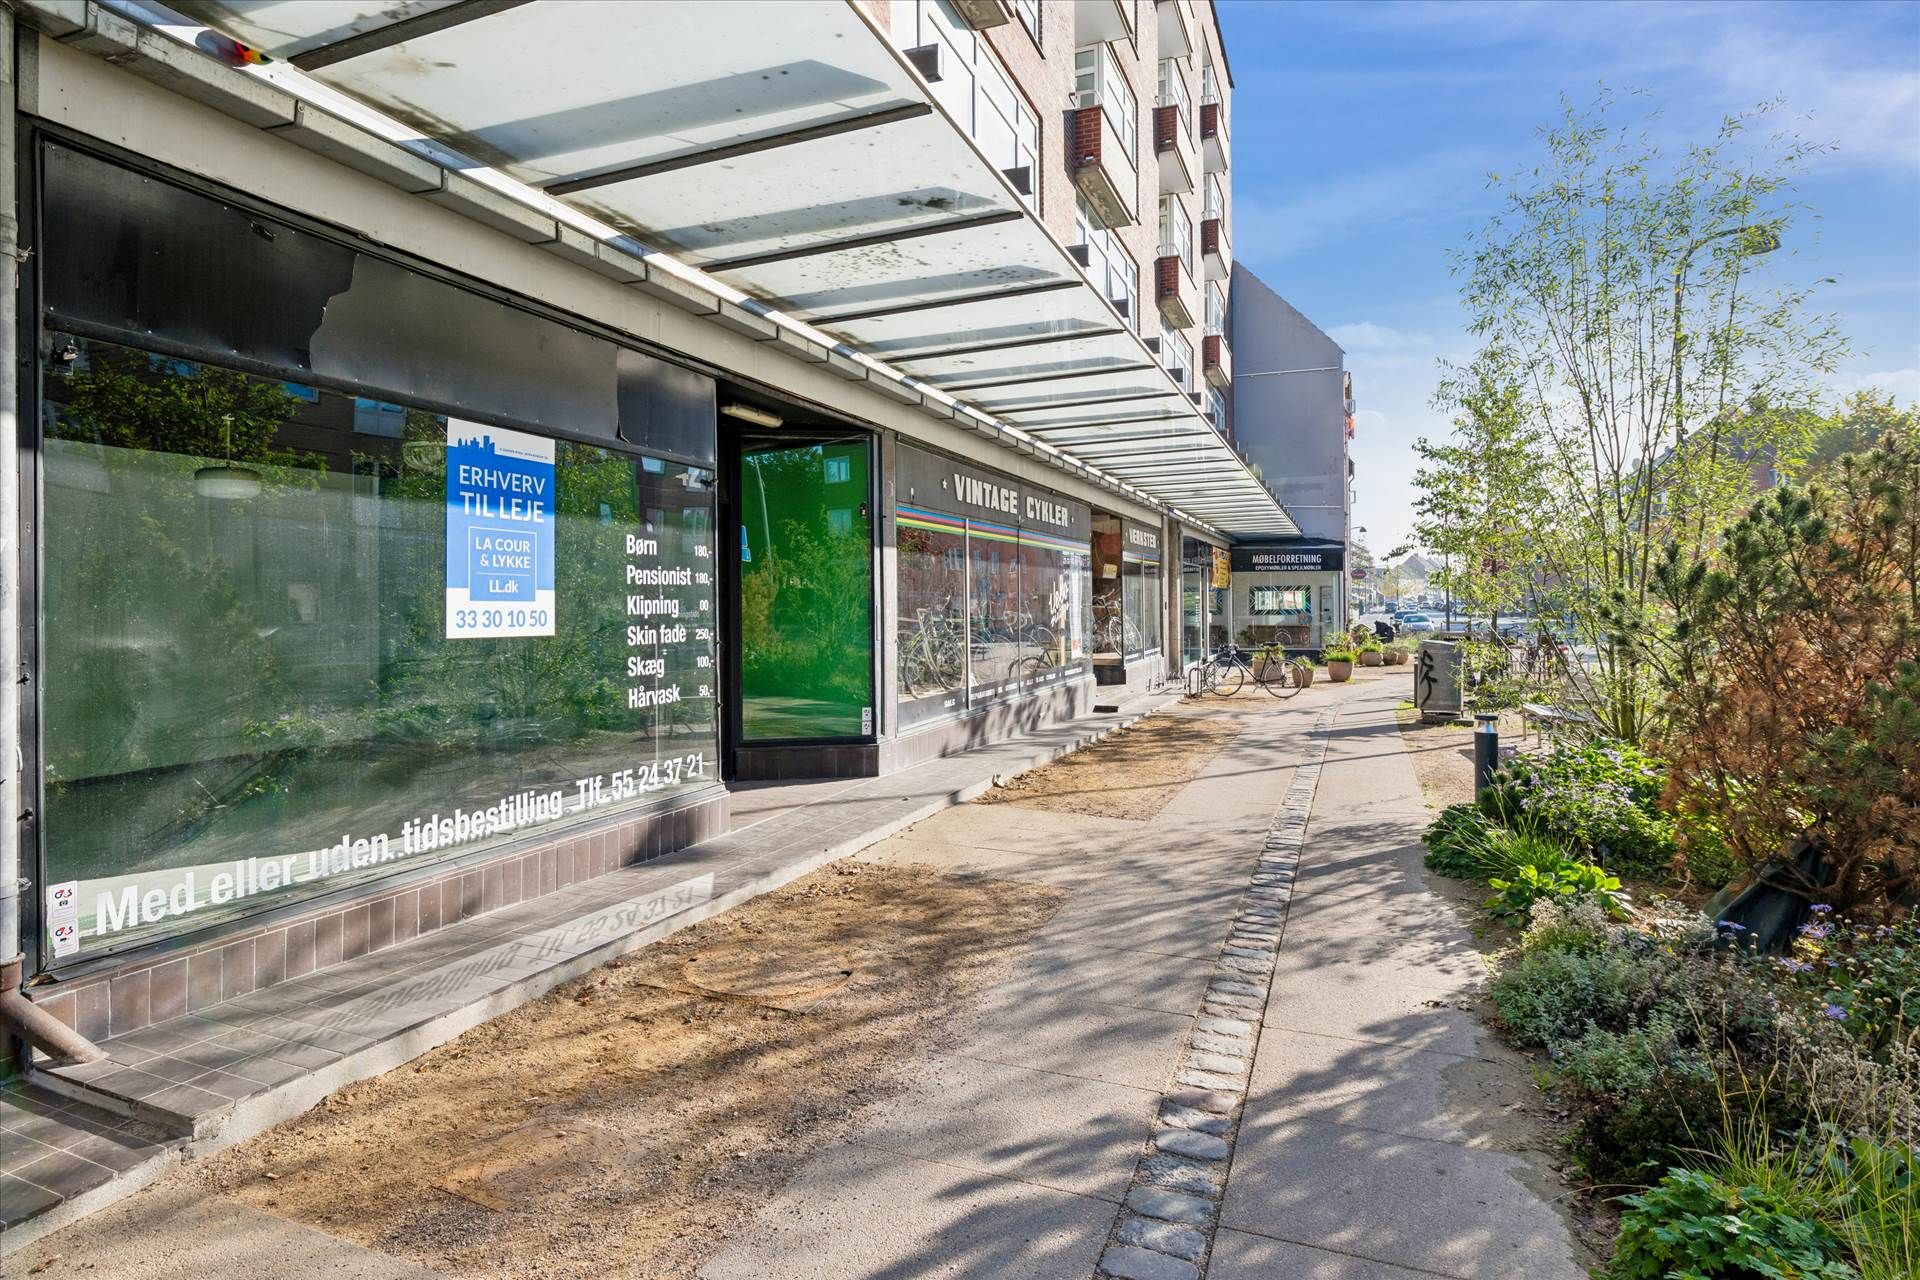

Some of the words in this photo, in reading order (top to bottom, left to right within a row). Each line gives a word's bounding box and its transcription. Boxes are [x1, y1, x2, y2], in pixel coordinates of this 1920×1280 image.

[459, 464, 546, 496] ERHVERV
[459, 491, 495, 518] TIL
[500, 496, 545, 523] LEJE
[953, 474, 1018, 514] VINTAGE
[1026, 496, 1069, 527] CYKLER
[475, 536, 492, 551] LA
[495, 538, 530, 553] COUR
[626, 534, 657, 556] Børn
[694, 545, 713, 558] 180,-
[480, 553, 489, 567] &
[492, 554, 531, 569] LYKKE
[1252, 554, 1322, 564] MØBELFORRETNING
[489, 579, 519, 593] LL.dk
[626, 564, 692, 585] Pensionist
[695, 572, 713, 586] 180,-
[627, 595, 679, 619] Klipning
[456, 610, 477, 628] 33
[482, 610, 503, 628] 30
[507, 610, 526, 628] 10
[529, 610, 548, 627] 50
[627, 625, 657, 646] Skin
[660, 623, 687, 643] fade
[627, 656, 665, 678] Skæg
[628, 683, 681, 709] Hårvask
[96, 872, 196, 936] Med
[210, 857, 297, 905] eller
[309, 834, 389, 878] uden
[402, 790, 562, 854] tidsbestilling
[612, 769, 634, 800] 55
[639, 763, 659, 793] 24
[664, 757, 682, 784] 37
[687, 752, 703, 778] 21
